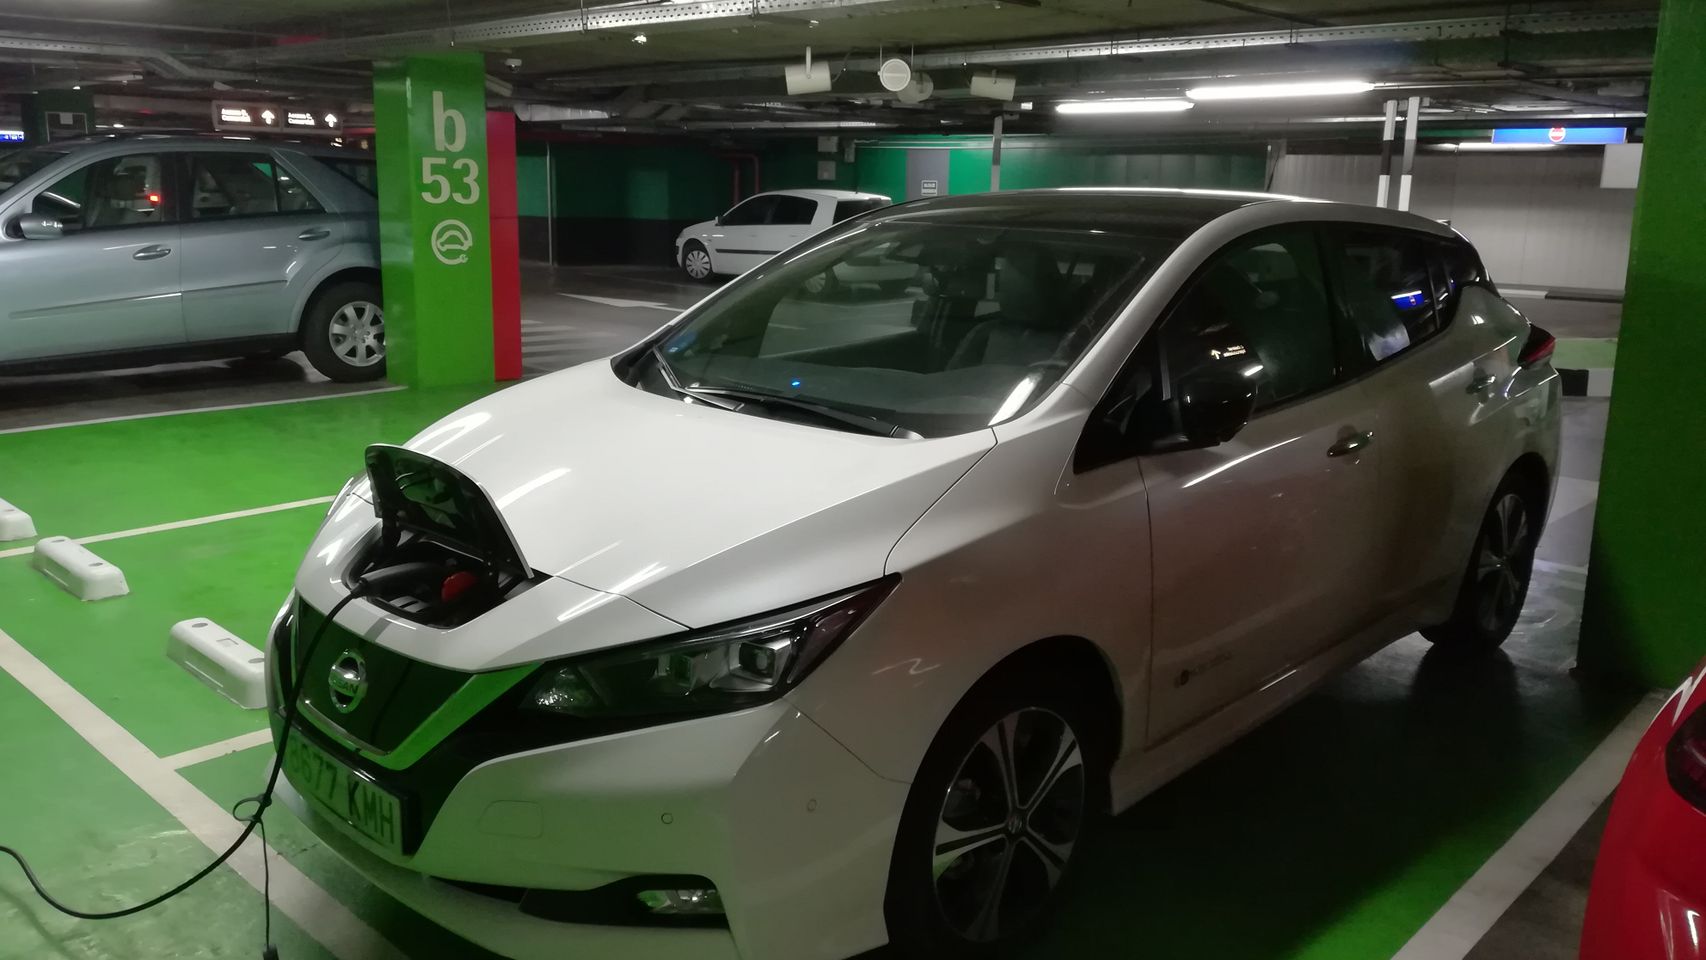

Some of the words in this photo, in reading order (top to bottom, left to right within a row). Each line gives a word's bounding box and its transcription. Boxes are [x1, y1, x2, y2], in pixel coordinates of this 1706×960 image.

[433, 91, 467, 152] b
[421, 157, 480, 204] 53
[346, 773, 394, 844] KMH
